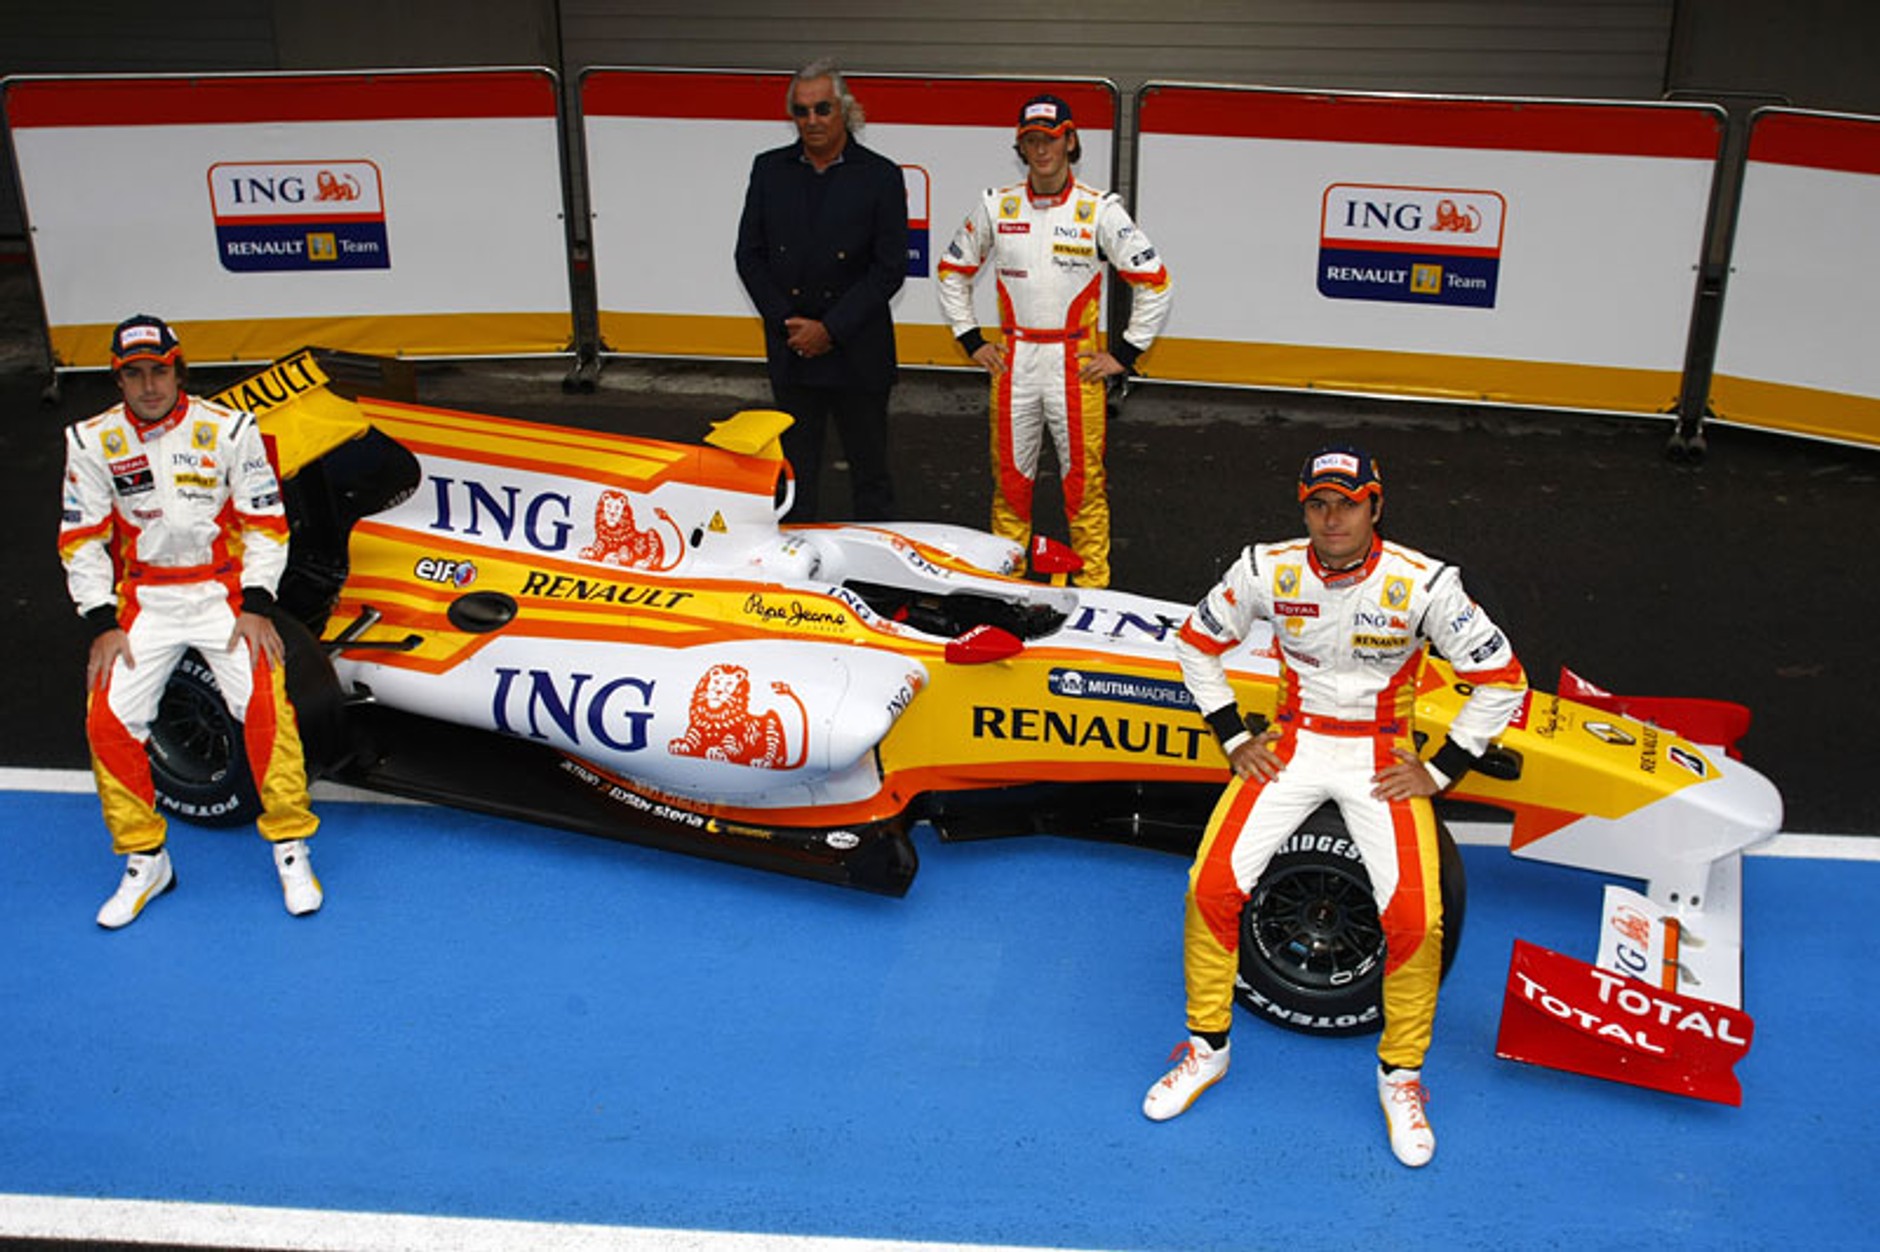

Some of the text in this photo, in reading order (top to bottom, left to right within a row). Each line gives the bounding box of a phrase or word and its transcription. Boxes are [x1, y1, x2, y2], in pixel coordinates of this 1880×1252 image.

[232, 177, 304, 203] ING
[1344, 200, 1423, 231] ING
[227, 240, 304, 256] RENAULT
[339, 239, 380, 254] Team
[1053, 226, 1078, 239] ING
[1327, 265, 1408, 284] RENAULT
[1446, 272, 1487, 290] Team
[172, 453, 198, 467] ING
[428, 475, 574, 552] ING
[415, 556, 456, 580] elf
[520, 571, 694, 609] RENAULT
[828, 587, 871, 620] ING
[743, 592, 846, 627] Pepe Jeans
[1277, 602, 1317, 615] TOTAL
[1354, 613, 1386, 628] ING
[1355, 635, 1407, 647] RENAULT
[493, 667, 656, 752] ING
[887, 686, 912, 718] ING
[973, 705, 1211, 761] RENAULT
[1516, 971, 1666, 1053] TOTAL
[1591, 969, 1746, 1046] TOTAL
